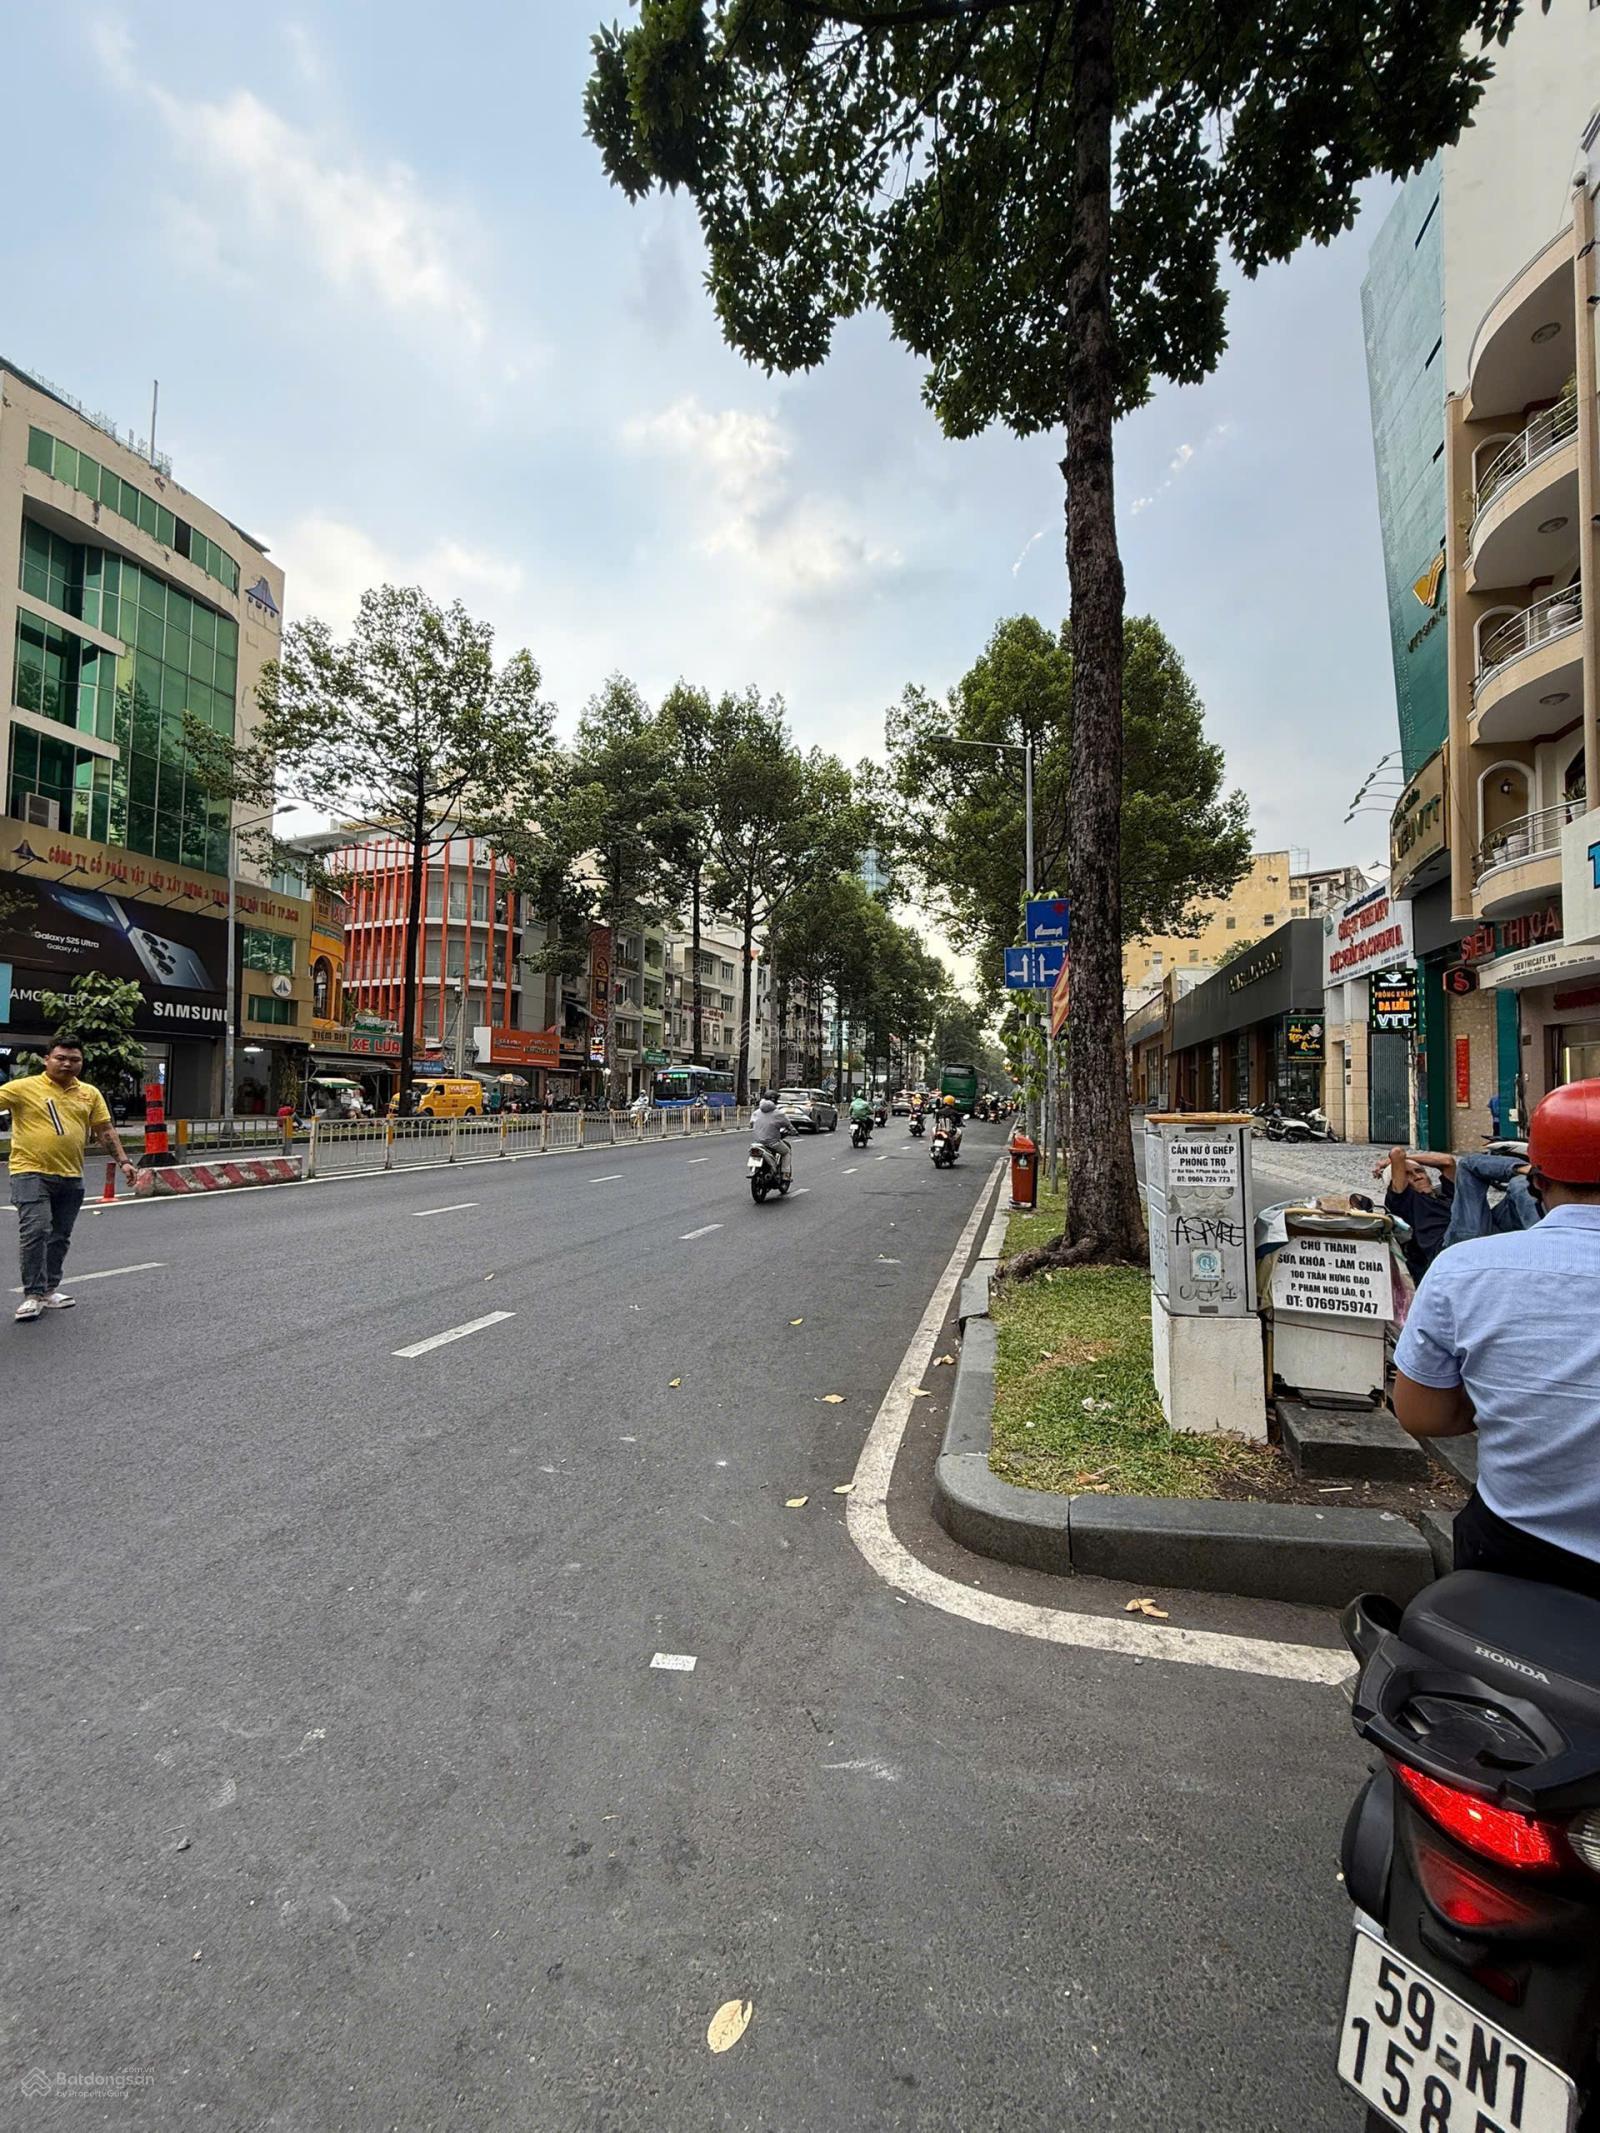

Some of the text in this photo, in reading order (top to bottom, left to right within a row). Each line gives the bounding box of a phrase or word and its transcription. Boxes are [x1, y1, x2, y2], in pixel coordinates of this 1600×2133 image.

[33, 931, 100, 949] Galaxy S25 Ultra
[46, 943, 71, 954] Galaxy
[1376, 1013, 1412, 1026] VTT
[352, 1038, 371, 1052] XE
[1290, 1270, 1305, 1279] 100
[1359, 1289, 1366, 1299] Q
[1305, 1296, 1379, 1315] 0769759747
[1474, 1645, 1551, 1685] HONDA
